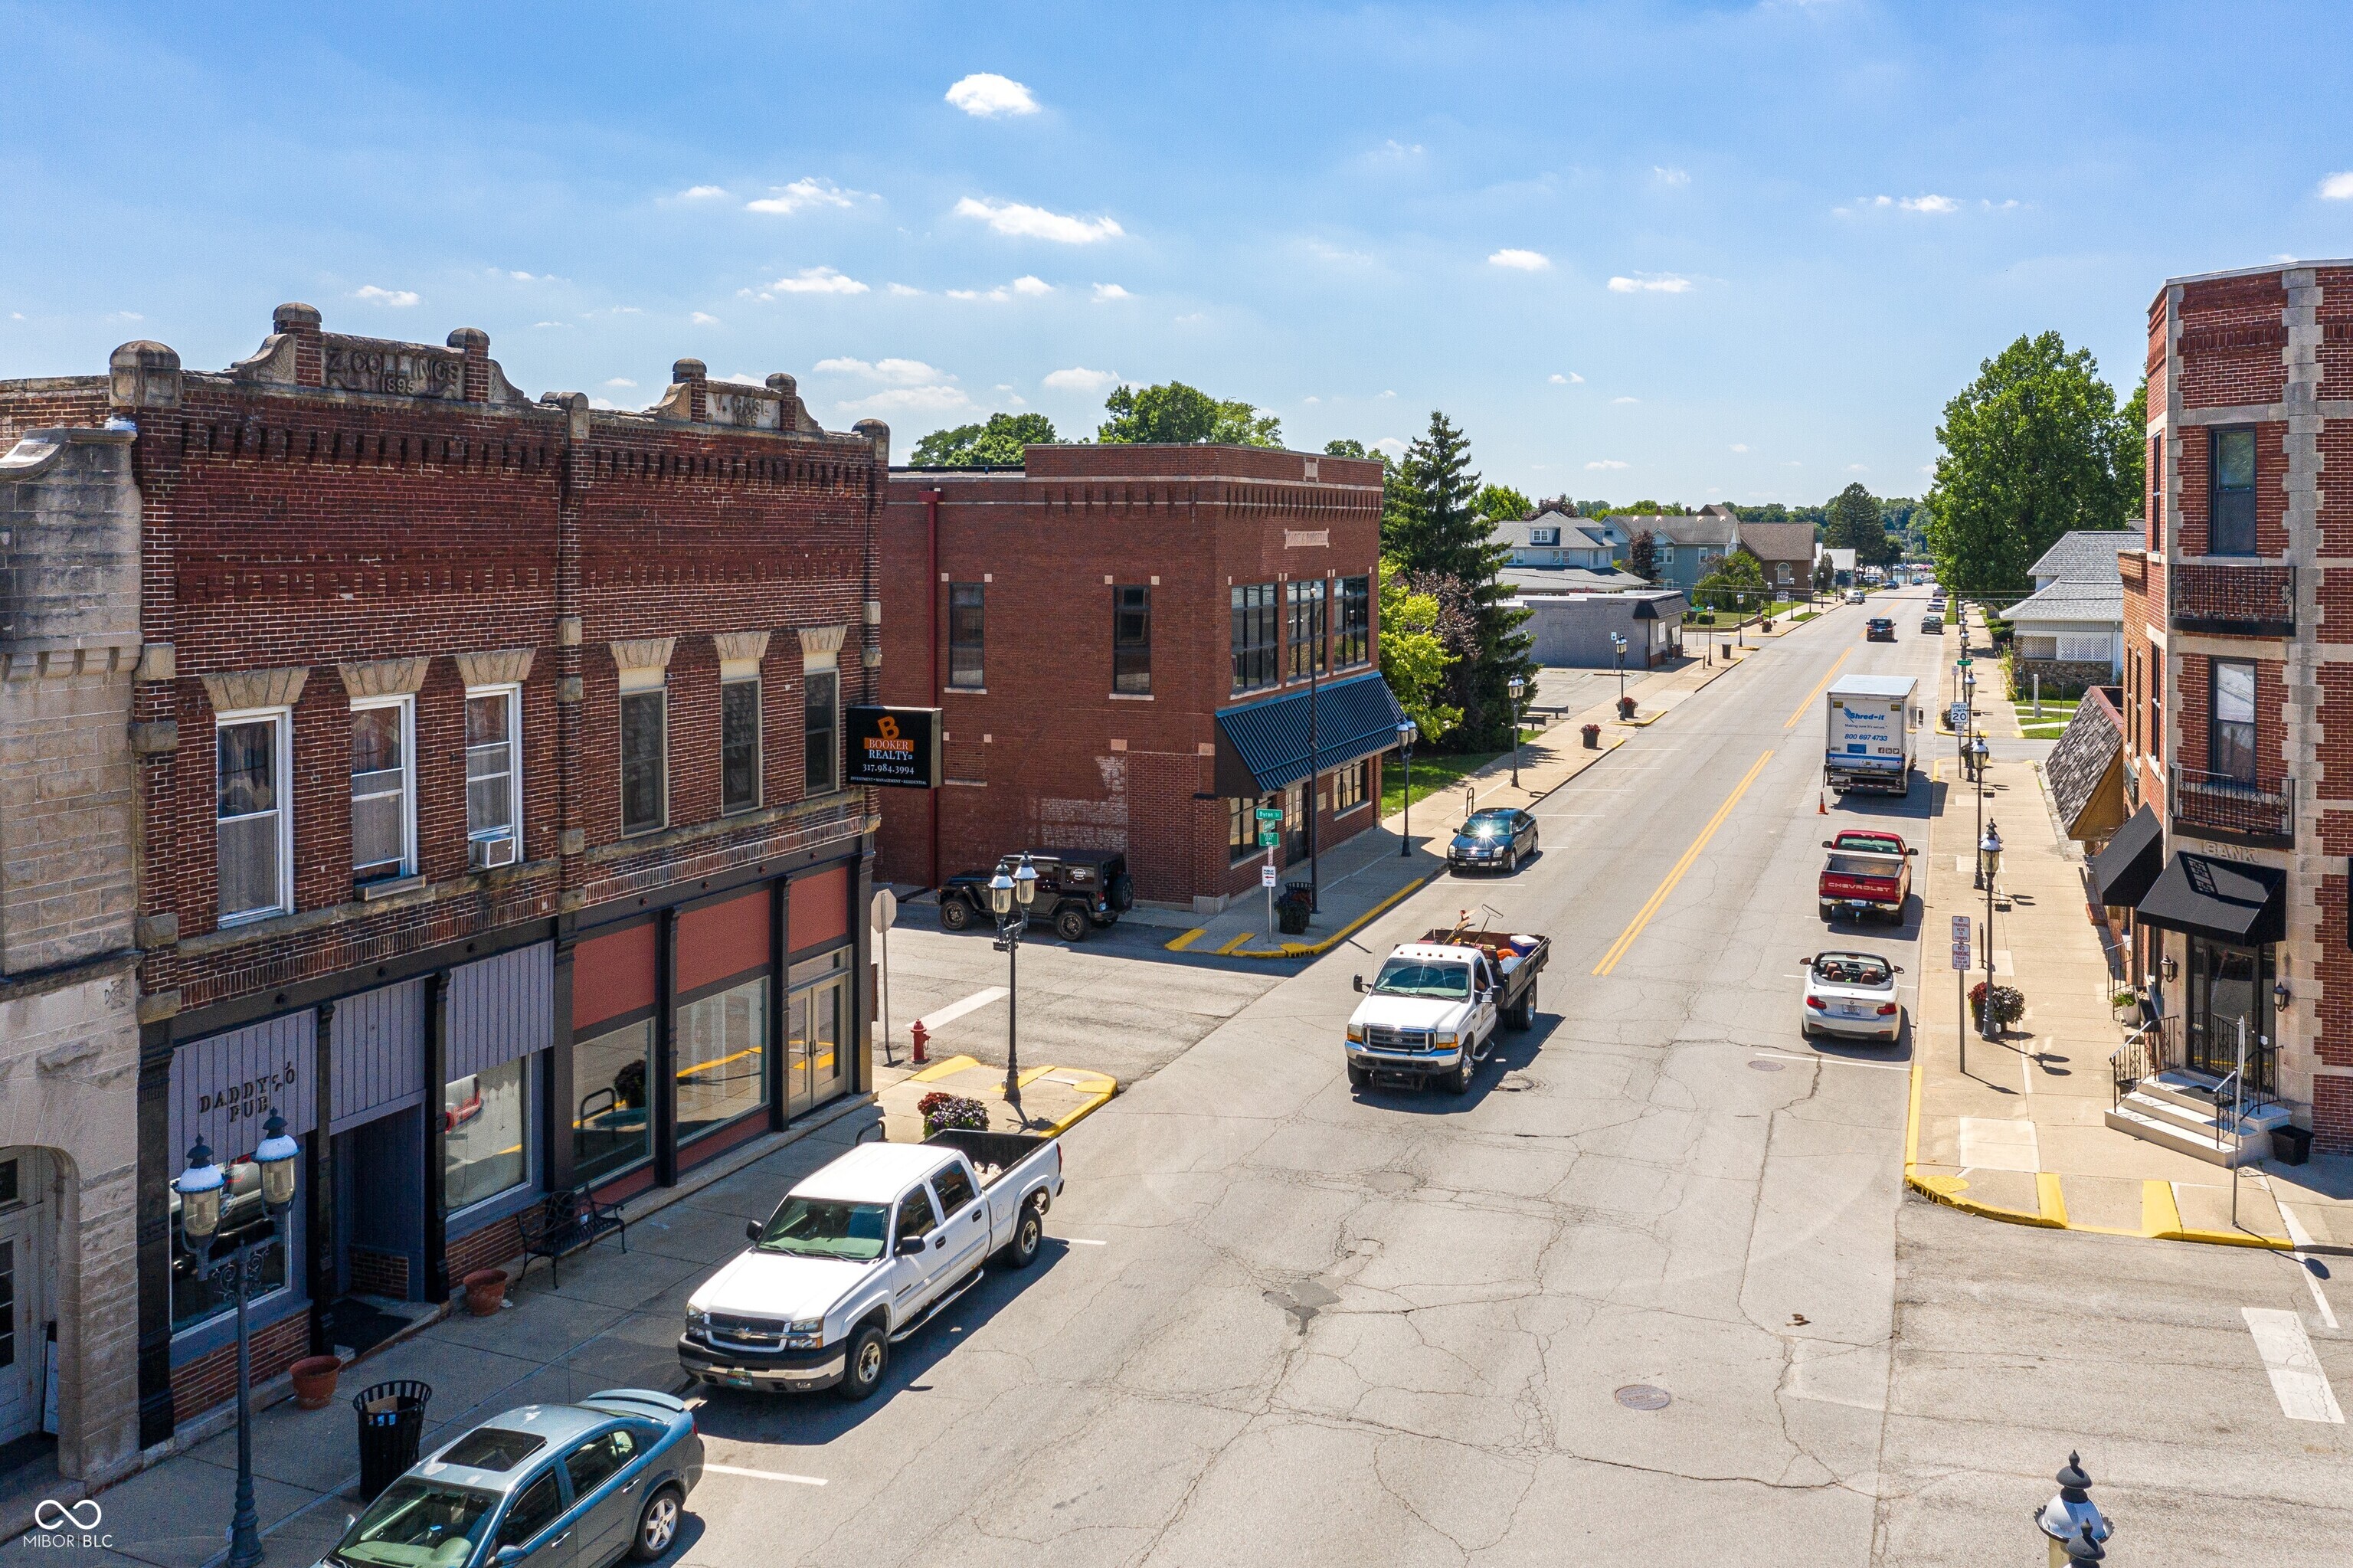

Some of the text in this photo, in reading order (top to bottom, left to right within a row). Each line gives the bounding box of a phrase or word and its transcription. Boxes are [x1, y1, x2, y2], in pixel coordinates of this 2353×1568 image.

[381, 375, 416, 394] 1895
[1953, 712, 1966, 721] 20
[877, 715, 899, 740] B
[869, 739, 909, 750] BOOKER
[869, 749, 909, 761] REALTY
[862, 763, 915, 775] 317.984.3994
[2202, 841, 2259, 863] BANK
[1828, 882, 1890, 892] CHEVROLET
[229, 1095, 268, 1123] PUB
